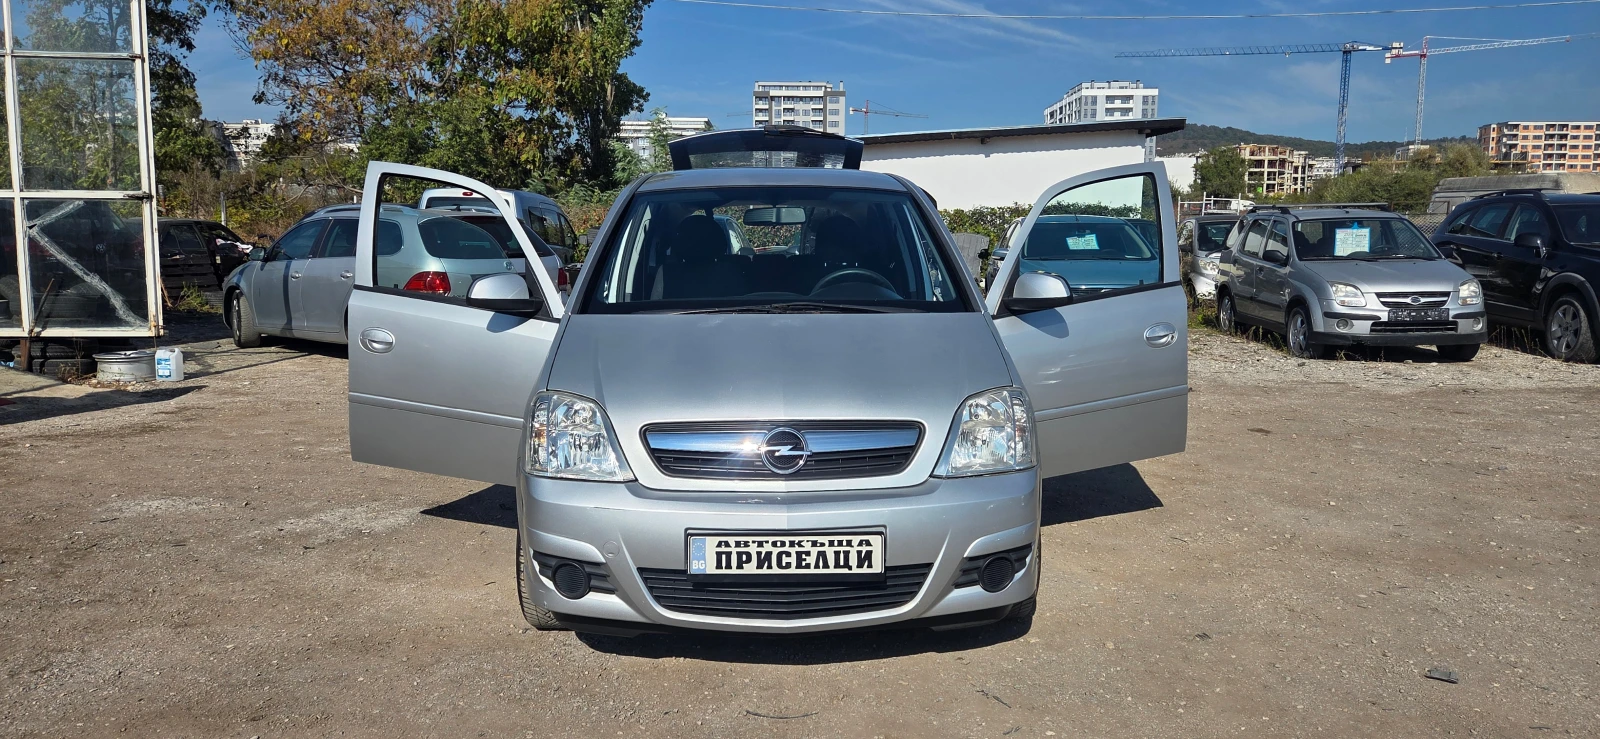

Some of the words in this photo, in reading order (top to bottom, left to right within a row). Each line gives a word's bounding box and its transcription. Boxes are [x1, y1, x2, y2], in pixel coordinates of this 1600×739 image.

[715, 539, 873, 548] АВТОКЪЩА
[692, 560, 706, 569] BG
[715, 550, 873, 571] ПРИСЕЛЦИ
